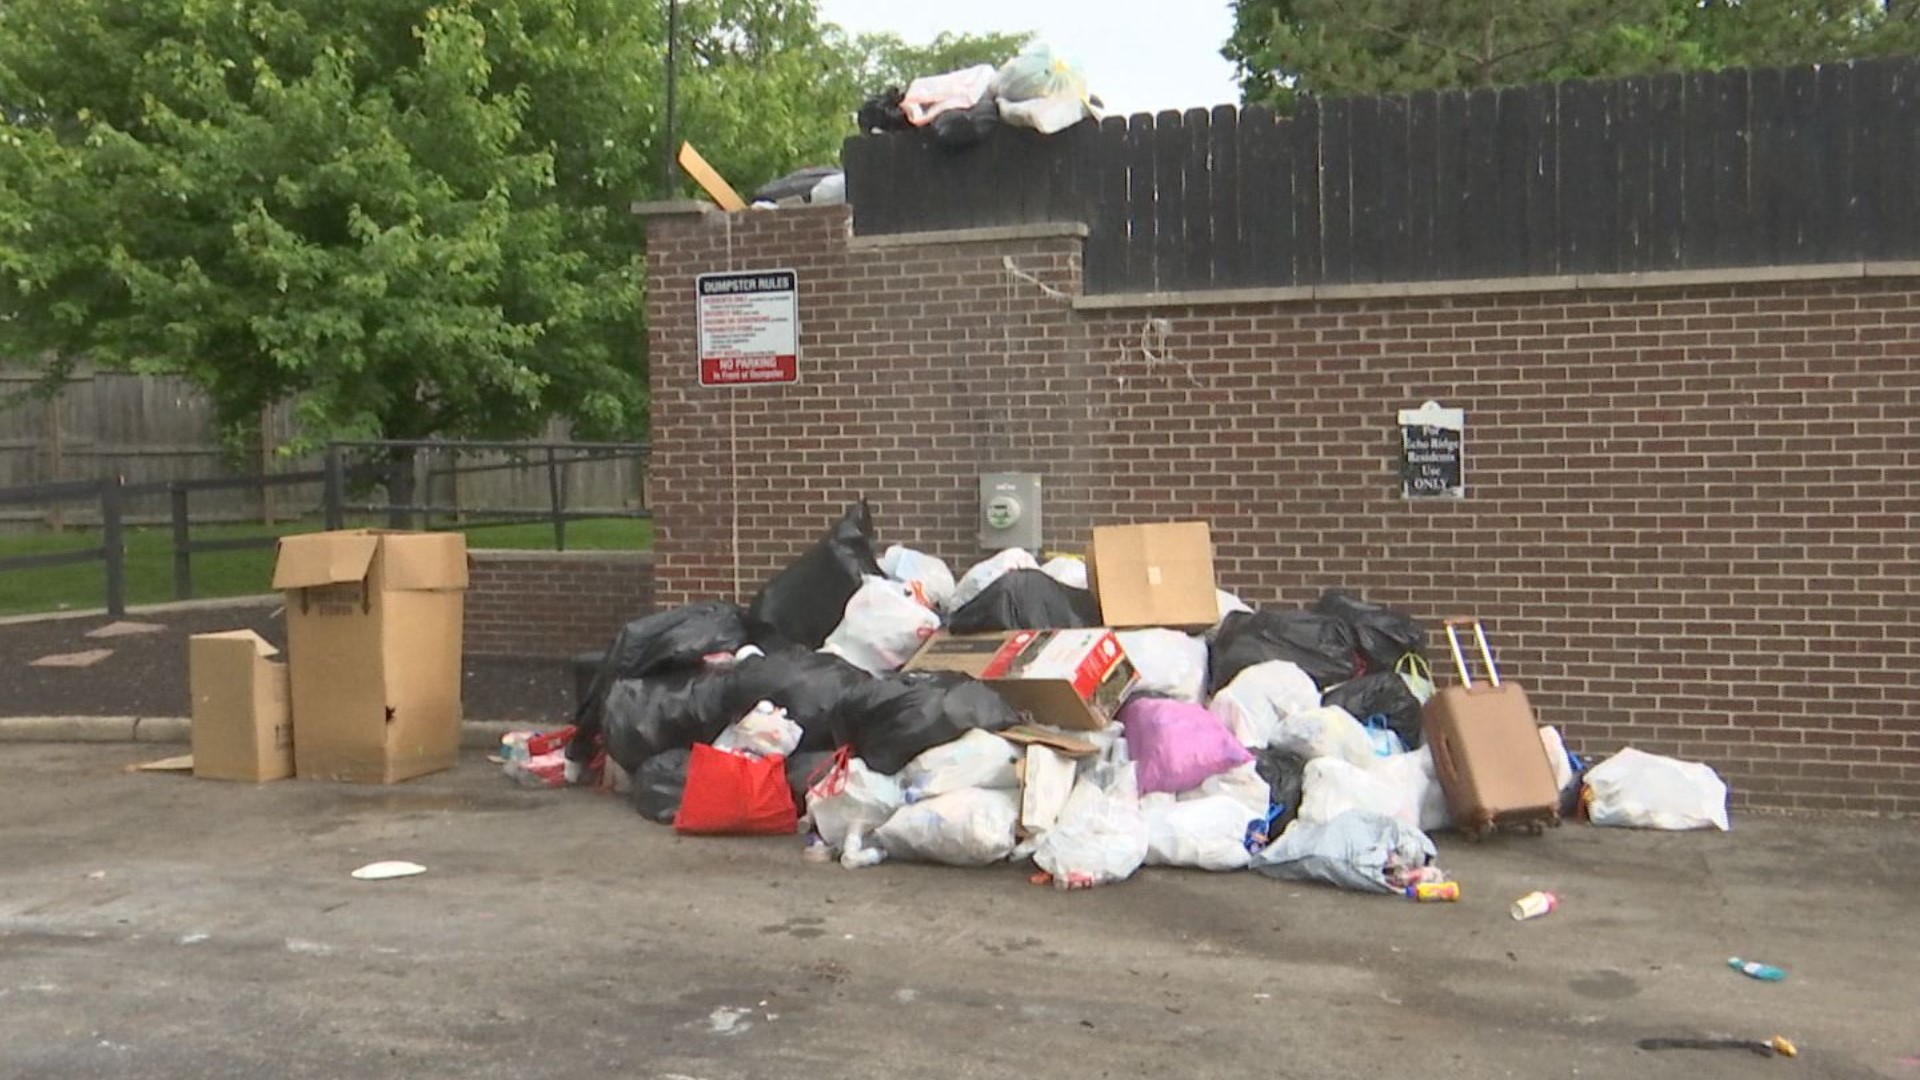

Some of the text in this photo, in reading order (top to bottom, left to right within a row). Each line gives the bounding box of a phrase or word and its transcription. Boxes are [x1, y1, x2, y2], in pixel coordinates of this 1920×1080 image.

[704, 276, 789, 292] DUMPSTER RULES
[719, 357, 777, 370] NO PARKING
[721, 371, 740, 380] Front
[750, 370, 784, 379] Dumpster
[1407, 451, 1456, 462] Residents
[1421, 465, 1441, 476] Use
[1413, 478, 1448, 490] ONLY
